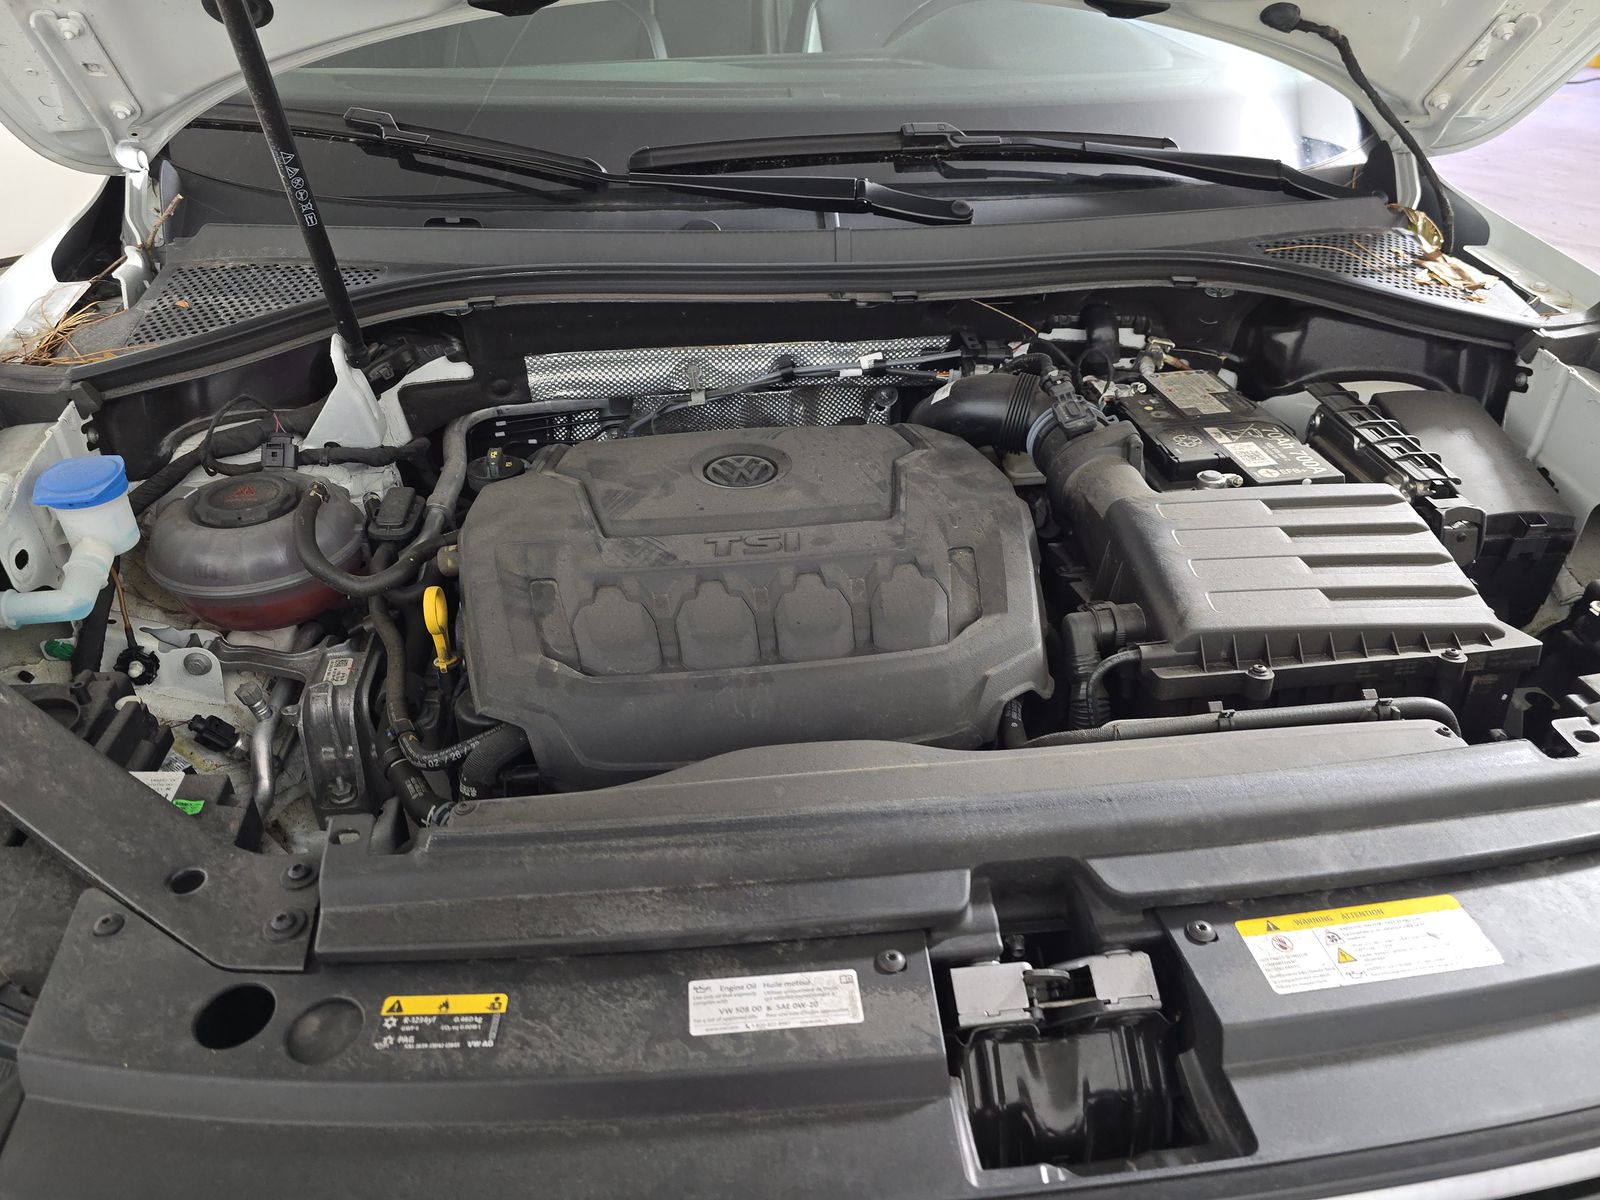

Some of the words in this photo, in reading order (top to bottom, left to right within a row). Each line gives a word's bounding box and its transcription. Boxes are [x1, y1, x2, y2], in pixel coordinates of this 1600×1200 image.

[1262, 427, 1295, 449] 70Ah
[1289, 449, 1327, 475] 700A
[703, 532, 800, 557] TSI
[428, 758, 440, 768] 02
[1292, 915, 1334, 927] WARNING
[1340, 907, 1385, 921] ATTENTION
[719, 984, 745, 993] Engine
[746, 982, 757, 990] Oil
[762, 981, 782, 989] Huile
[718, 1007, 734, 1015] VW
[734, 1006, 750, 1014] 508
[775, 1003, 791, 1011] SAE
[792, 1000, 819, 1009] 0W-20
[474, 1016, 483, 1024] kg
[397, 1035, 415, 1044] PAG
[482, 1040, 494, 1048] AG
